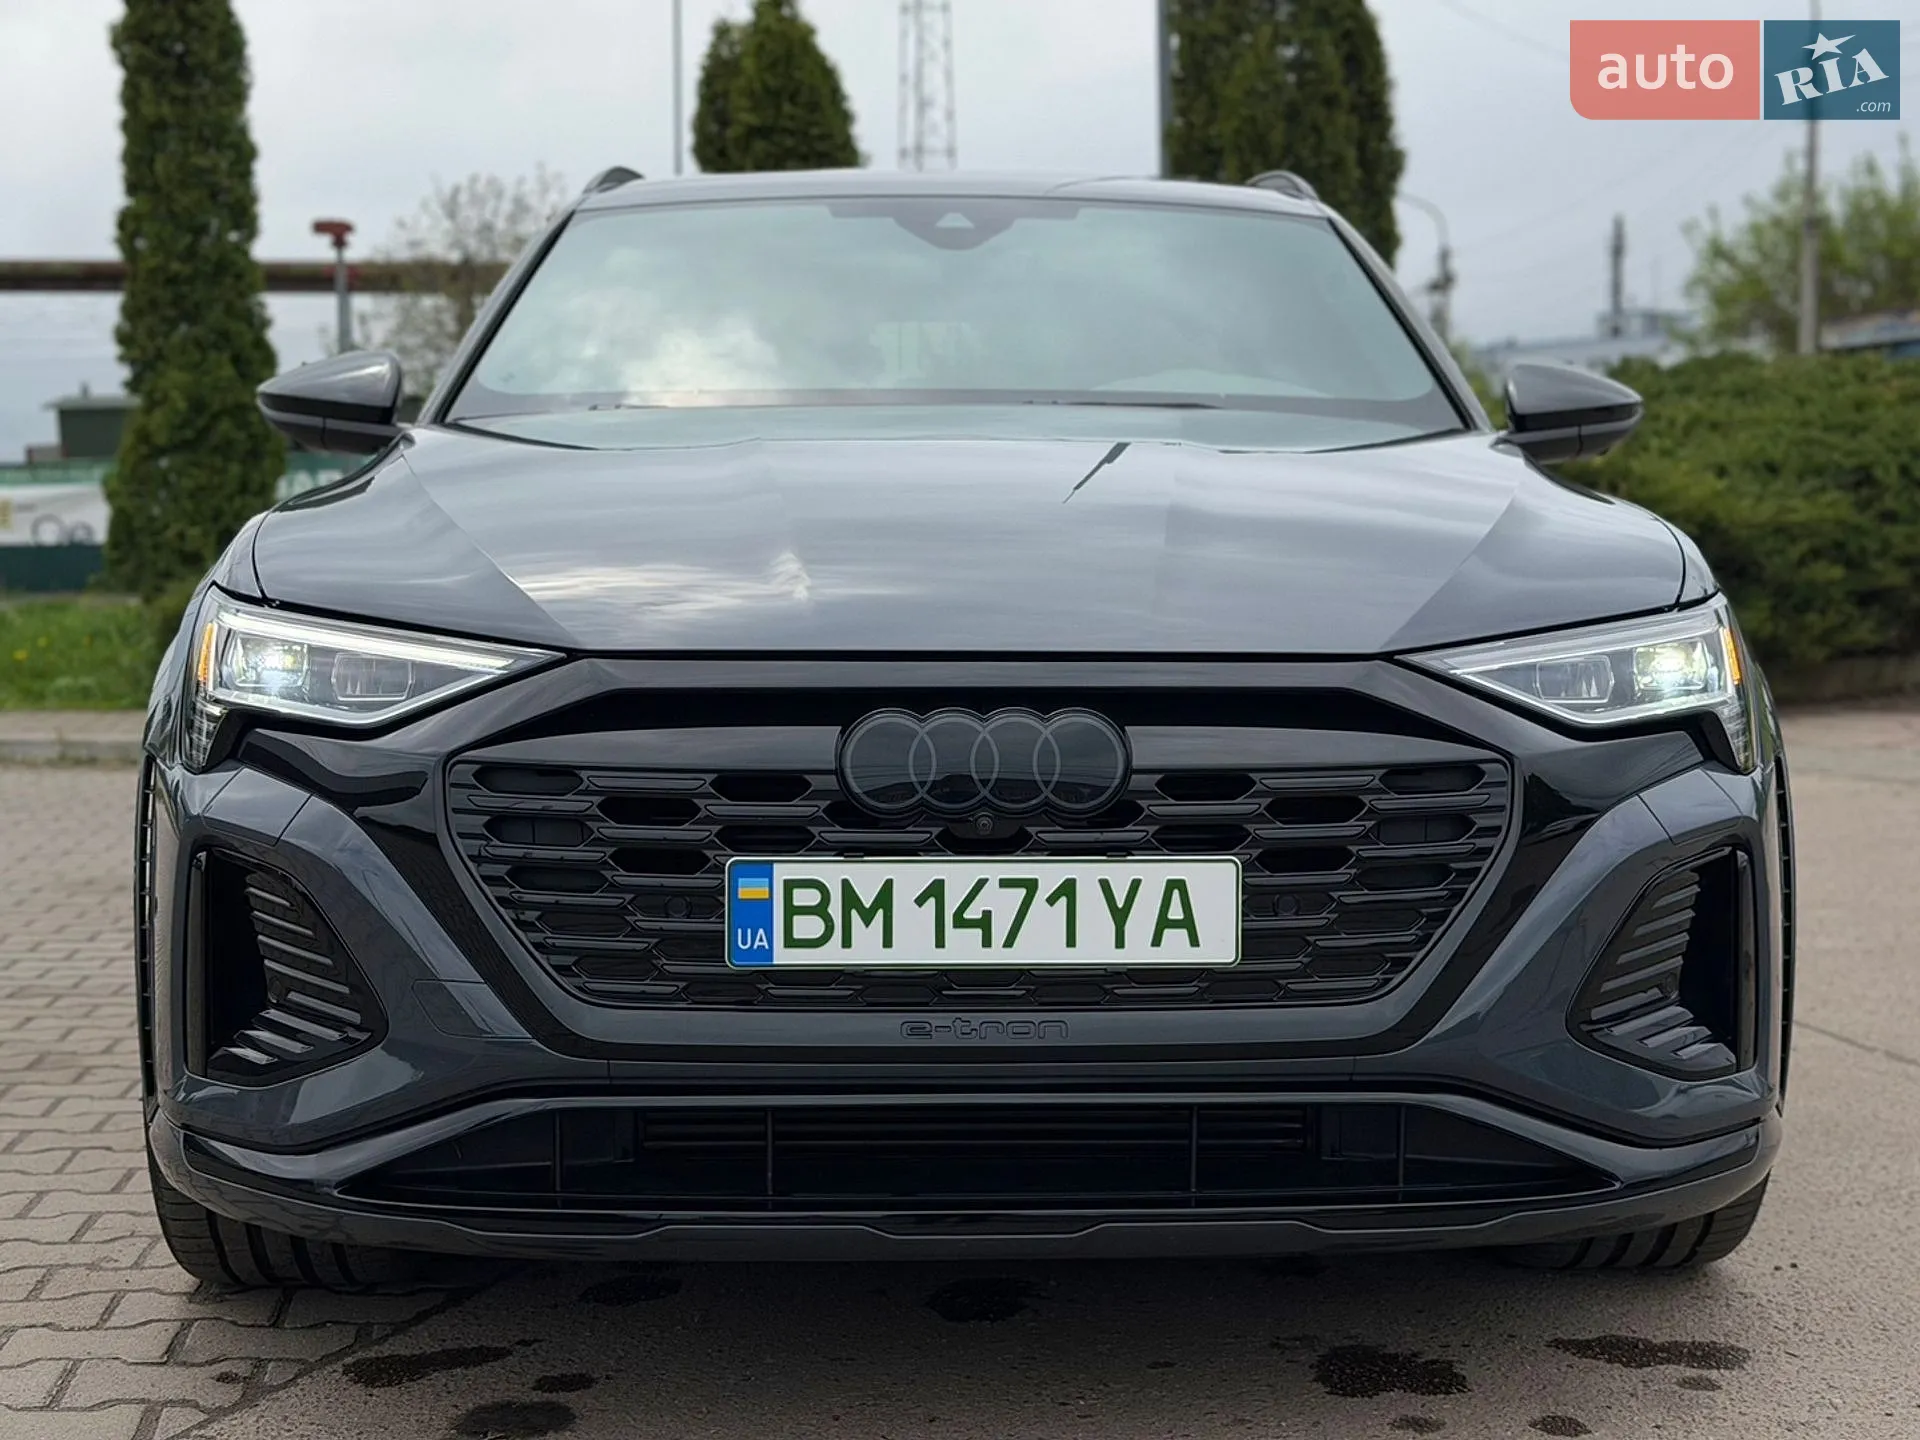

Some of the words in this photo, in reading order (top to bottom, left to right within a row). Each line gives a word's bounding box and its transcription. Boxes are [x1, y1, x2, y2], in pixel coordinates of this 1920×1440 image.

[782, 877, 894, 950] BM
[913, 877, 1078, 950] 1471
[1098, 877, 1201, 950] YA
[737, 927, 770, 951] UA
[899, 1016, 1069, 1041] e-tron
